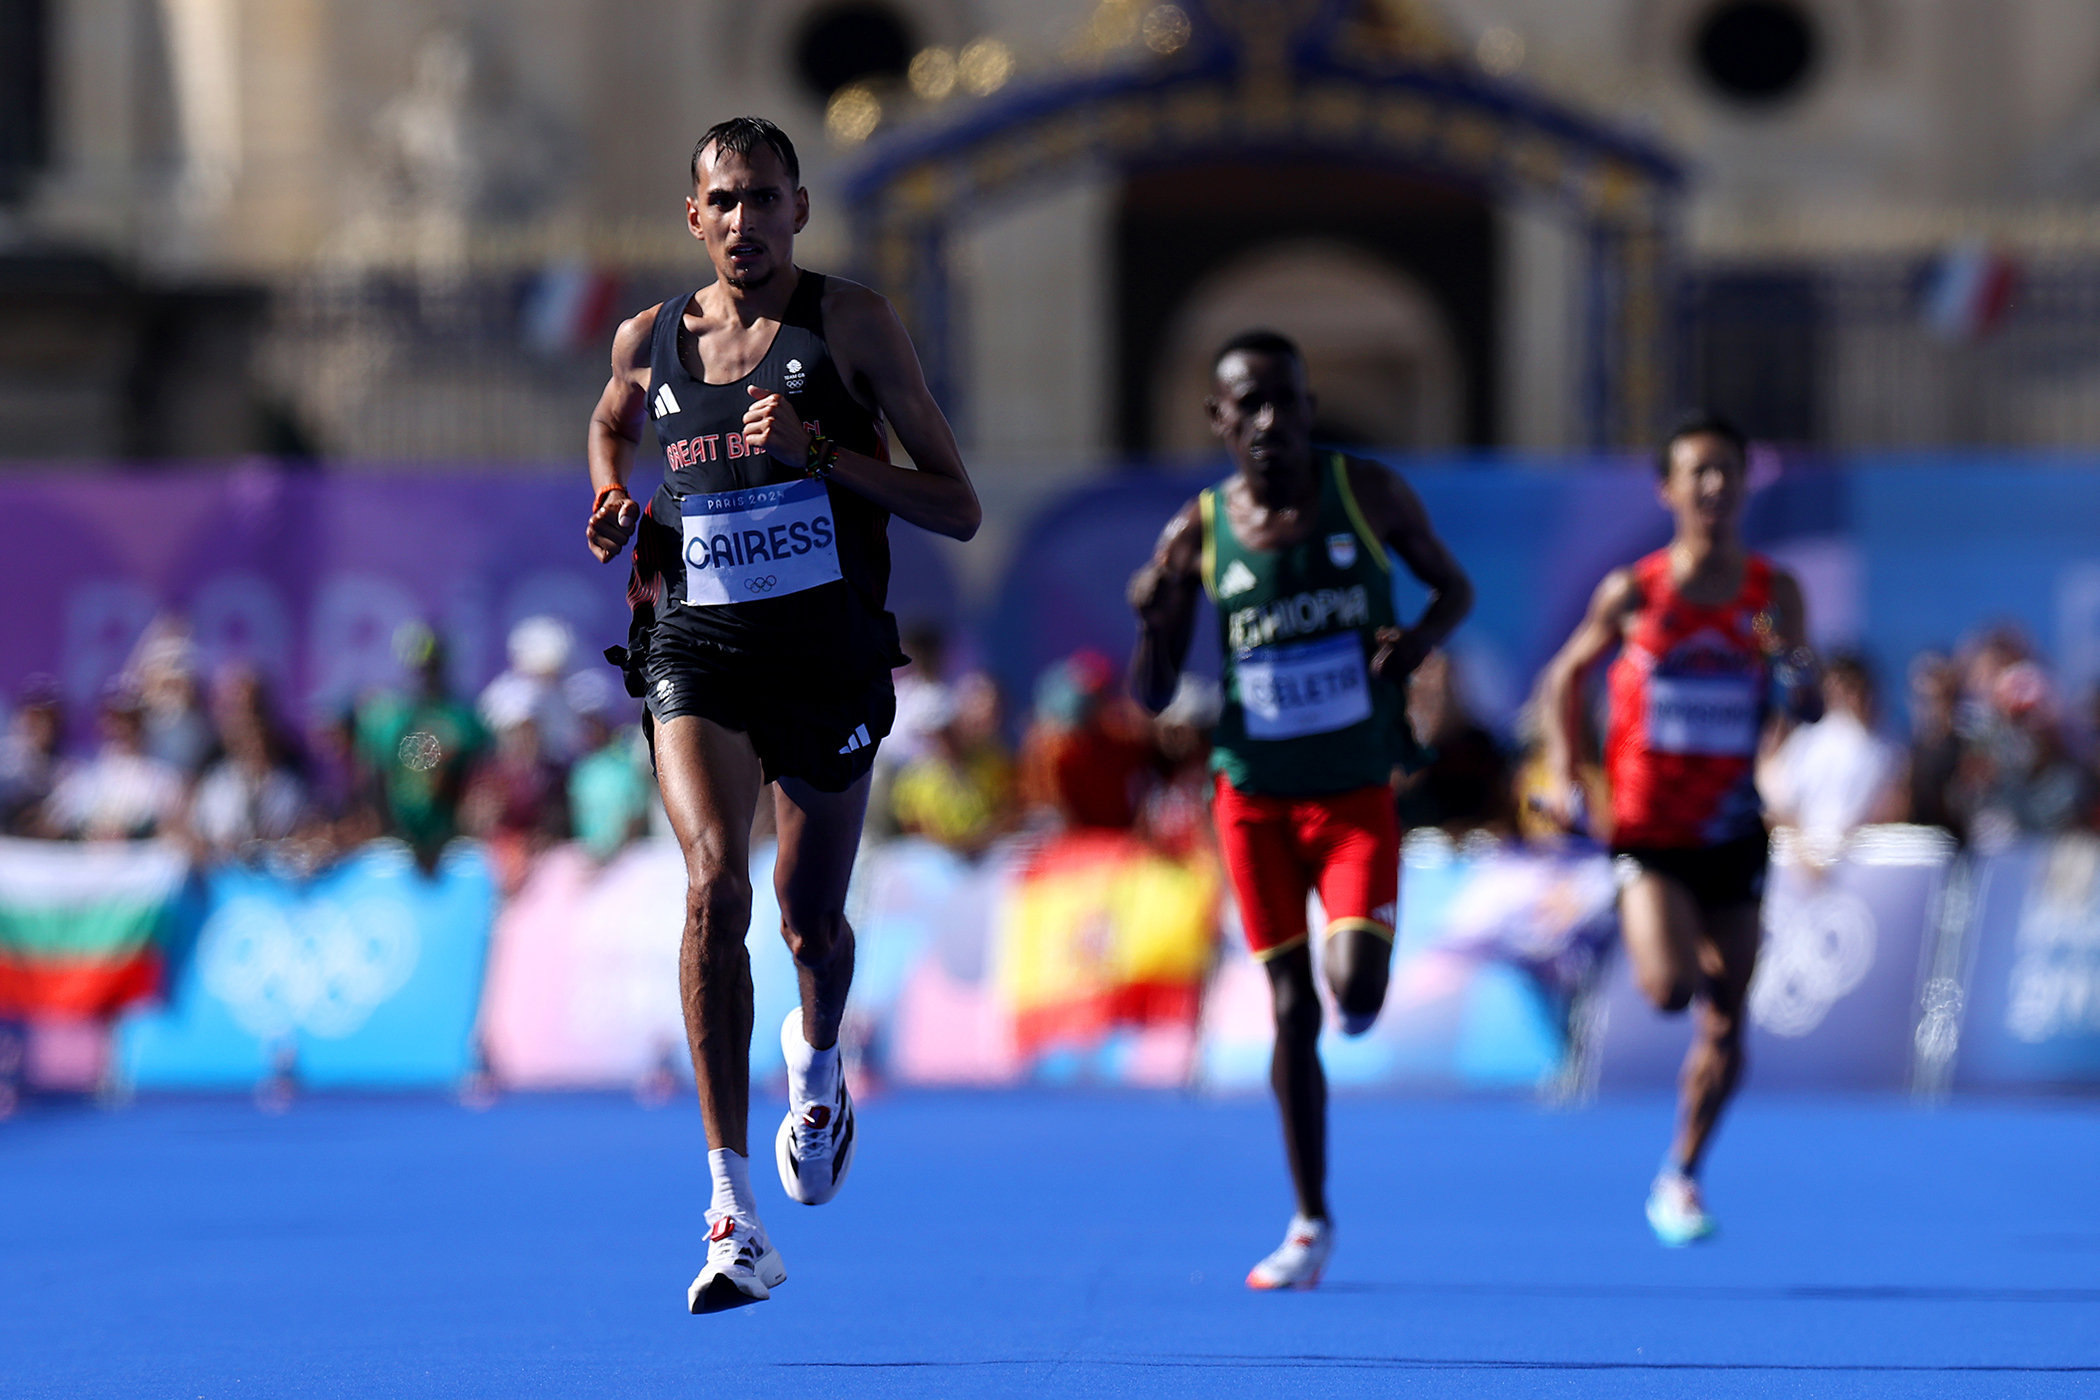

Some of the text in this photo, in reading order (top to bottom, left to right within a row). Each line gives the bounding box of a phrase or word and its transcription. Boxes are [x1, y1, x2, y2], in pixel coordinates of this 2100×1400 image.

[666, 434, 719, 472] GREAT
[707, 491, 785, 510] PARIS 2024
[685, 516, 833, 570] CAIRESS
